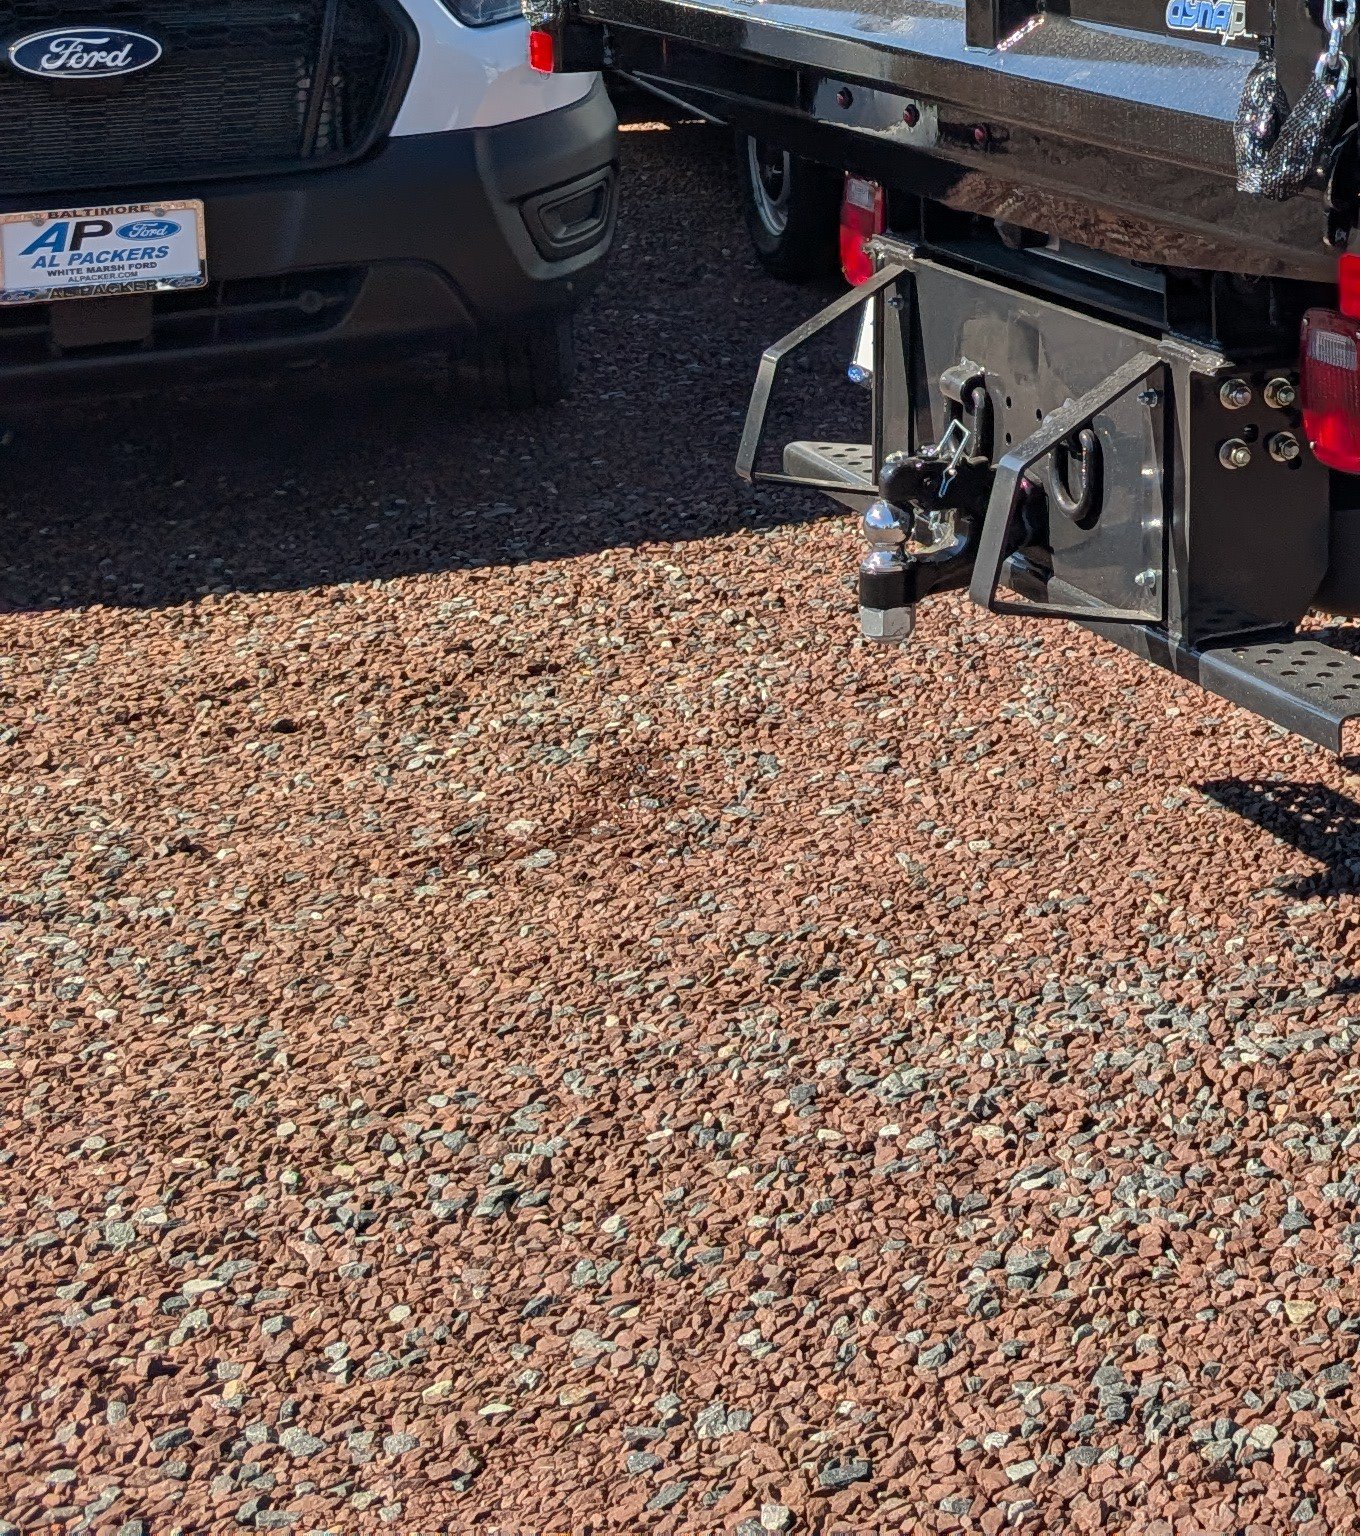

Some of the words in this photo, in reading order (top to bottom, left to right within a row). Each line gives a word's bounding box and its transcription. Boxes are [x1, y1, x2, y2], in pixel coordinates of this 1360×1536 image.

[40, 37, 133, 70] Ford
[48, 205, 150, 219] BALTIMORE
[18, 220, 113, 256] AP
[129, 221, 167, 238] Ford
[31, 255, 61, 269] AL
[67, 245, 170, 267] PACKERS
[47, 267, 83, 277] WHITE
[86, 265, 125, 274] MARSH
[128, 261, 158, 270] FORD
[68, 271, 139, 283] ALPACKER.COM
